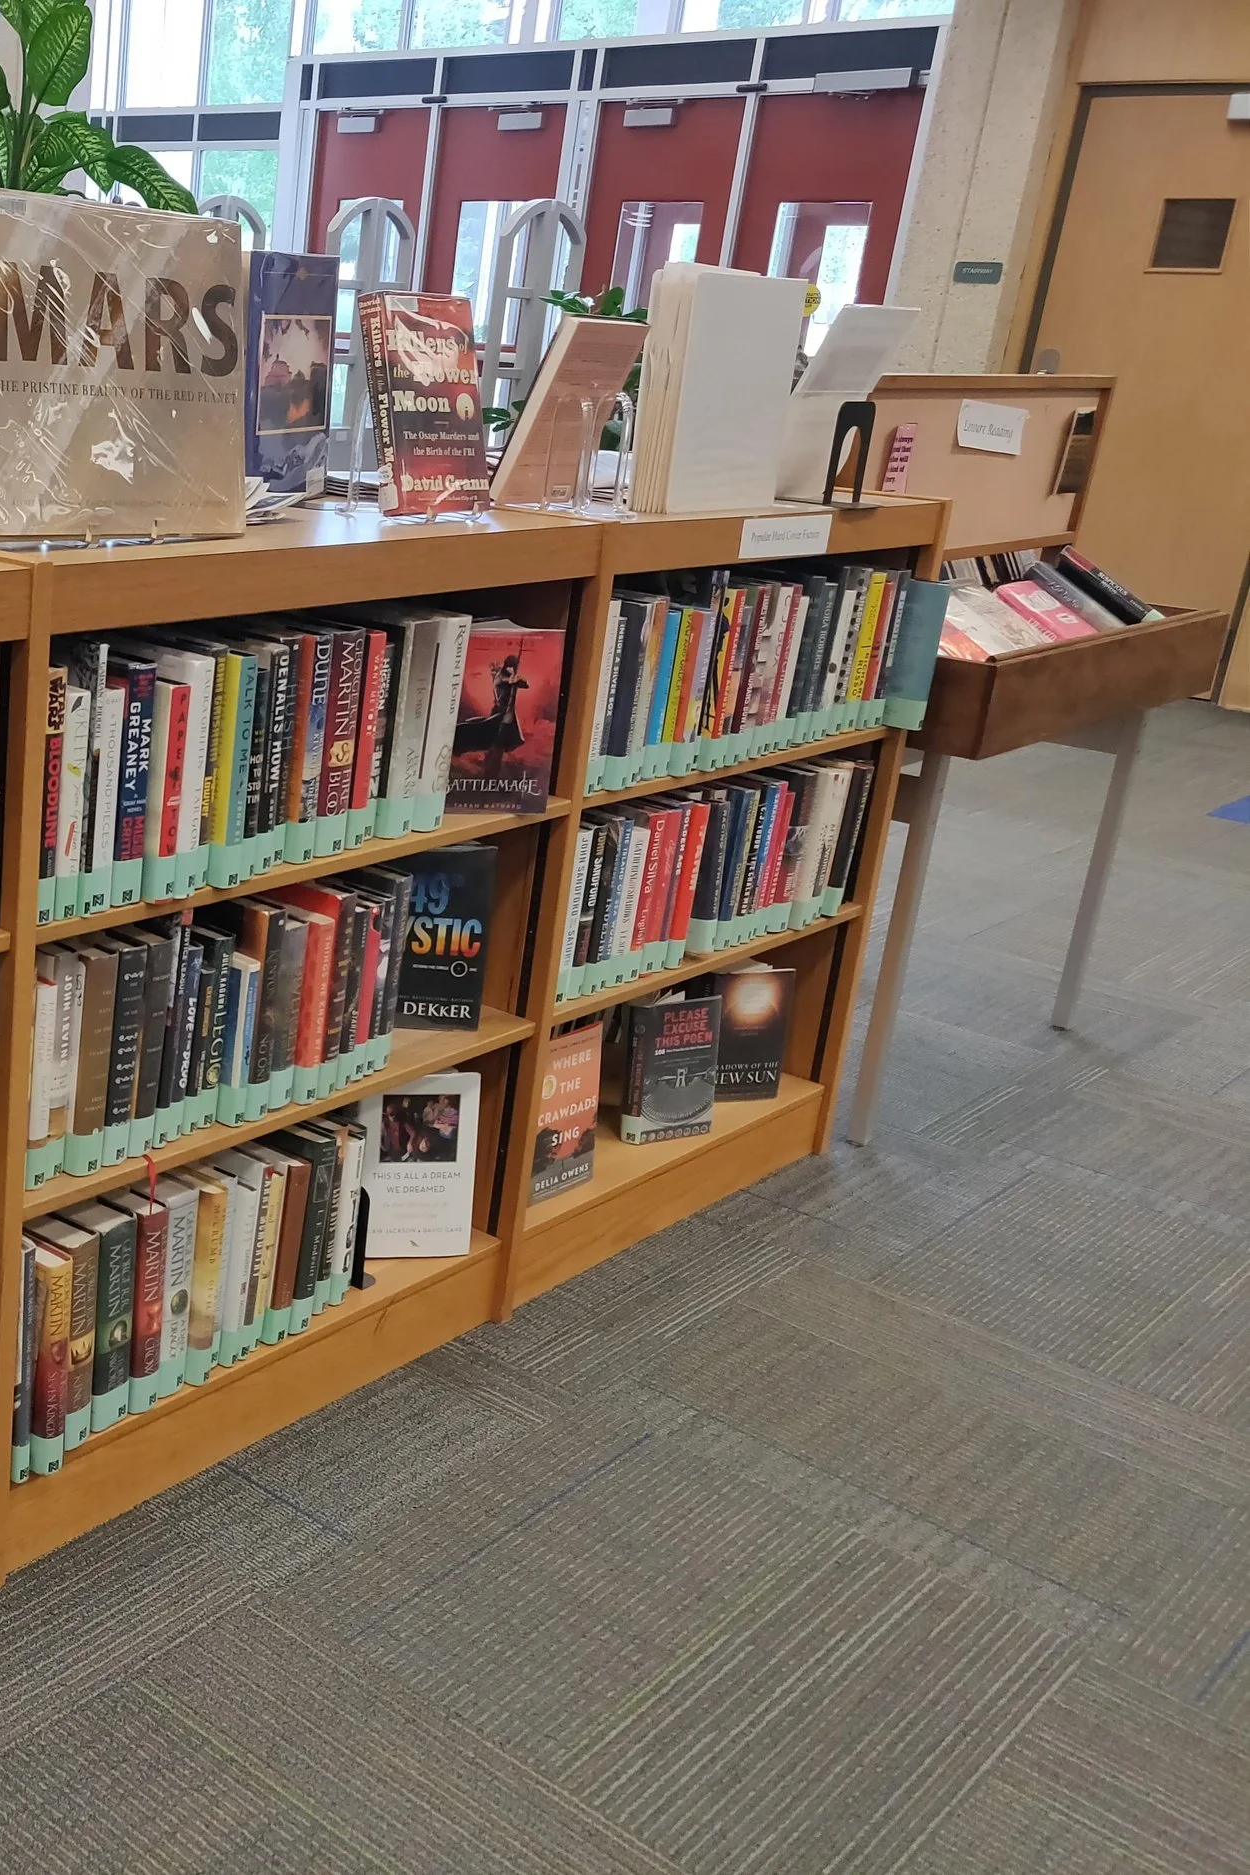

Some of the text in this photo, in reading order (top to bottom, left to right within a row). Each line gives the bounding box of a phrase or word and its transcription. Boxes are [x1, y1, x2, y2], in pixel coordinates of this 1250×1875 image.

[22, 381, 79, 395] PRISTINE
[130, 387, 145, 399] OF
[148, 388, 172, 400] THE
[174, 390, 194, 401] RED
[392, 390, 451, 413] Moon
[404, 431, 479, 441] The Osage Murders and
[413, 447, 475, 457] the Birth of the FBI
[401, 475, 489, 491] David Grann
[336, 640, 354, 736] MARTIN
[123, 702, 141, 791] GREANEY
[138, 718, 152, 772] MARK
[44, 738, 62, 848] BLOODLINE
[644, 819, 666, 893] Daniel Silva
[403, 1000, 472, 1019] DEKKER
[663, 1008, 709, 1021] PLEASE
[662, 1020, 708, 1034] EXCUSE
[654, 1031, 712, 1049] THIS POEM
[553, 1049, 592, 1071] WHERE
[559, 1080, 582, 1094] THE
[746, 1070, 778, 1083] SUN
[538, 1096, 598, 1126] CRAWDADS
[551, 1126, 580, 1147] SING
[372, 1171, 391, 1180] THIS
[394, 1171, 402, 1179] IS
[404, 1171, 419, 1179] ALL
[430, 1171, 461, 1180] DREAM
[534, 1162, 589, 1192] DELIA OWENS
[386, 1184, 446, 1193] WE DREAMED
[170, 1216, 185, 1288] MARTIN
[144, 1231, 159, 1302] MARTIN
[108, 1246, 122, 1318] MARTIN
[49, 1275, 64, 1337] MARTIN
[71, 1263, 87, 1338] MARTIN
